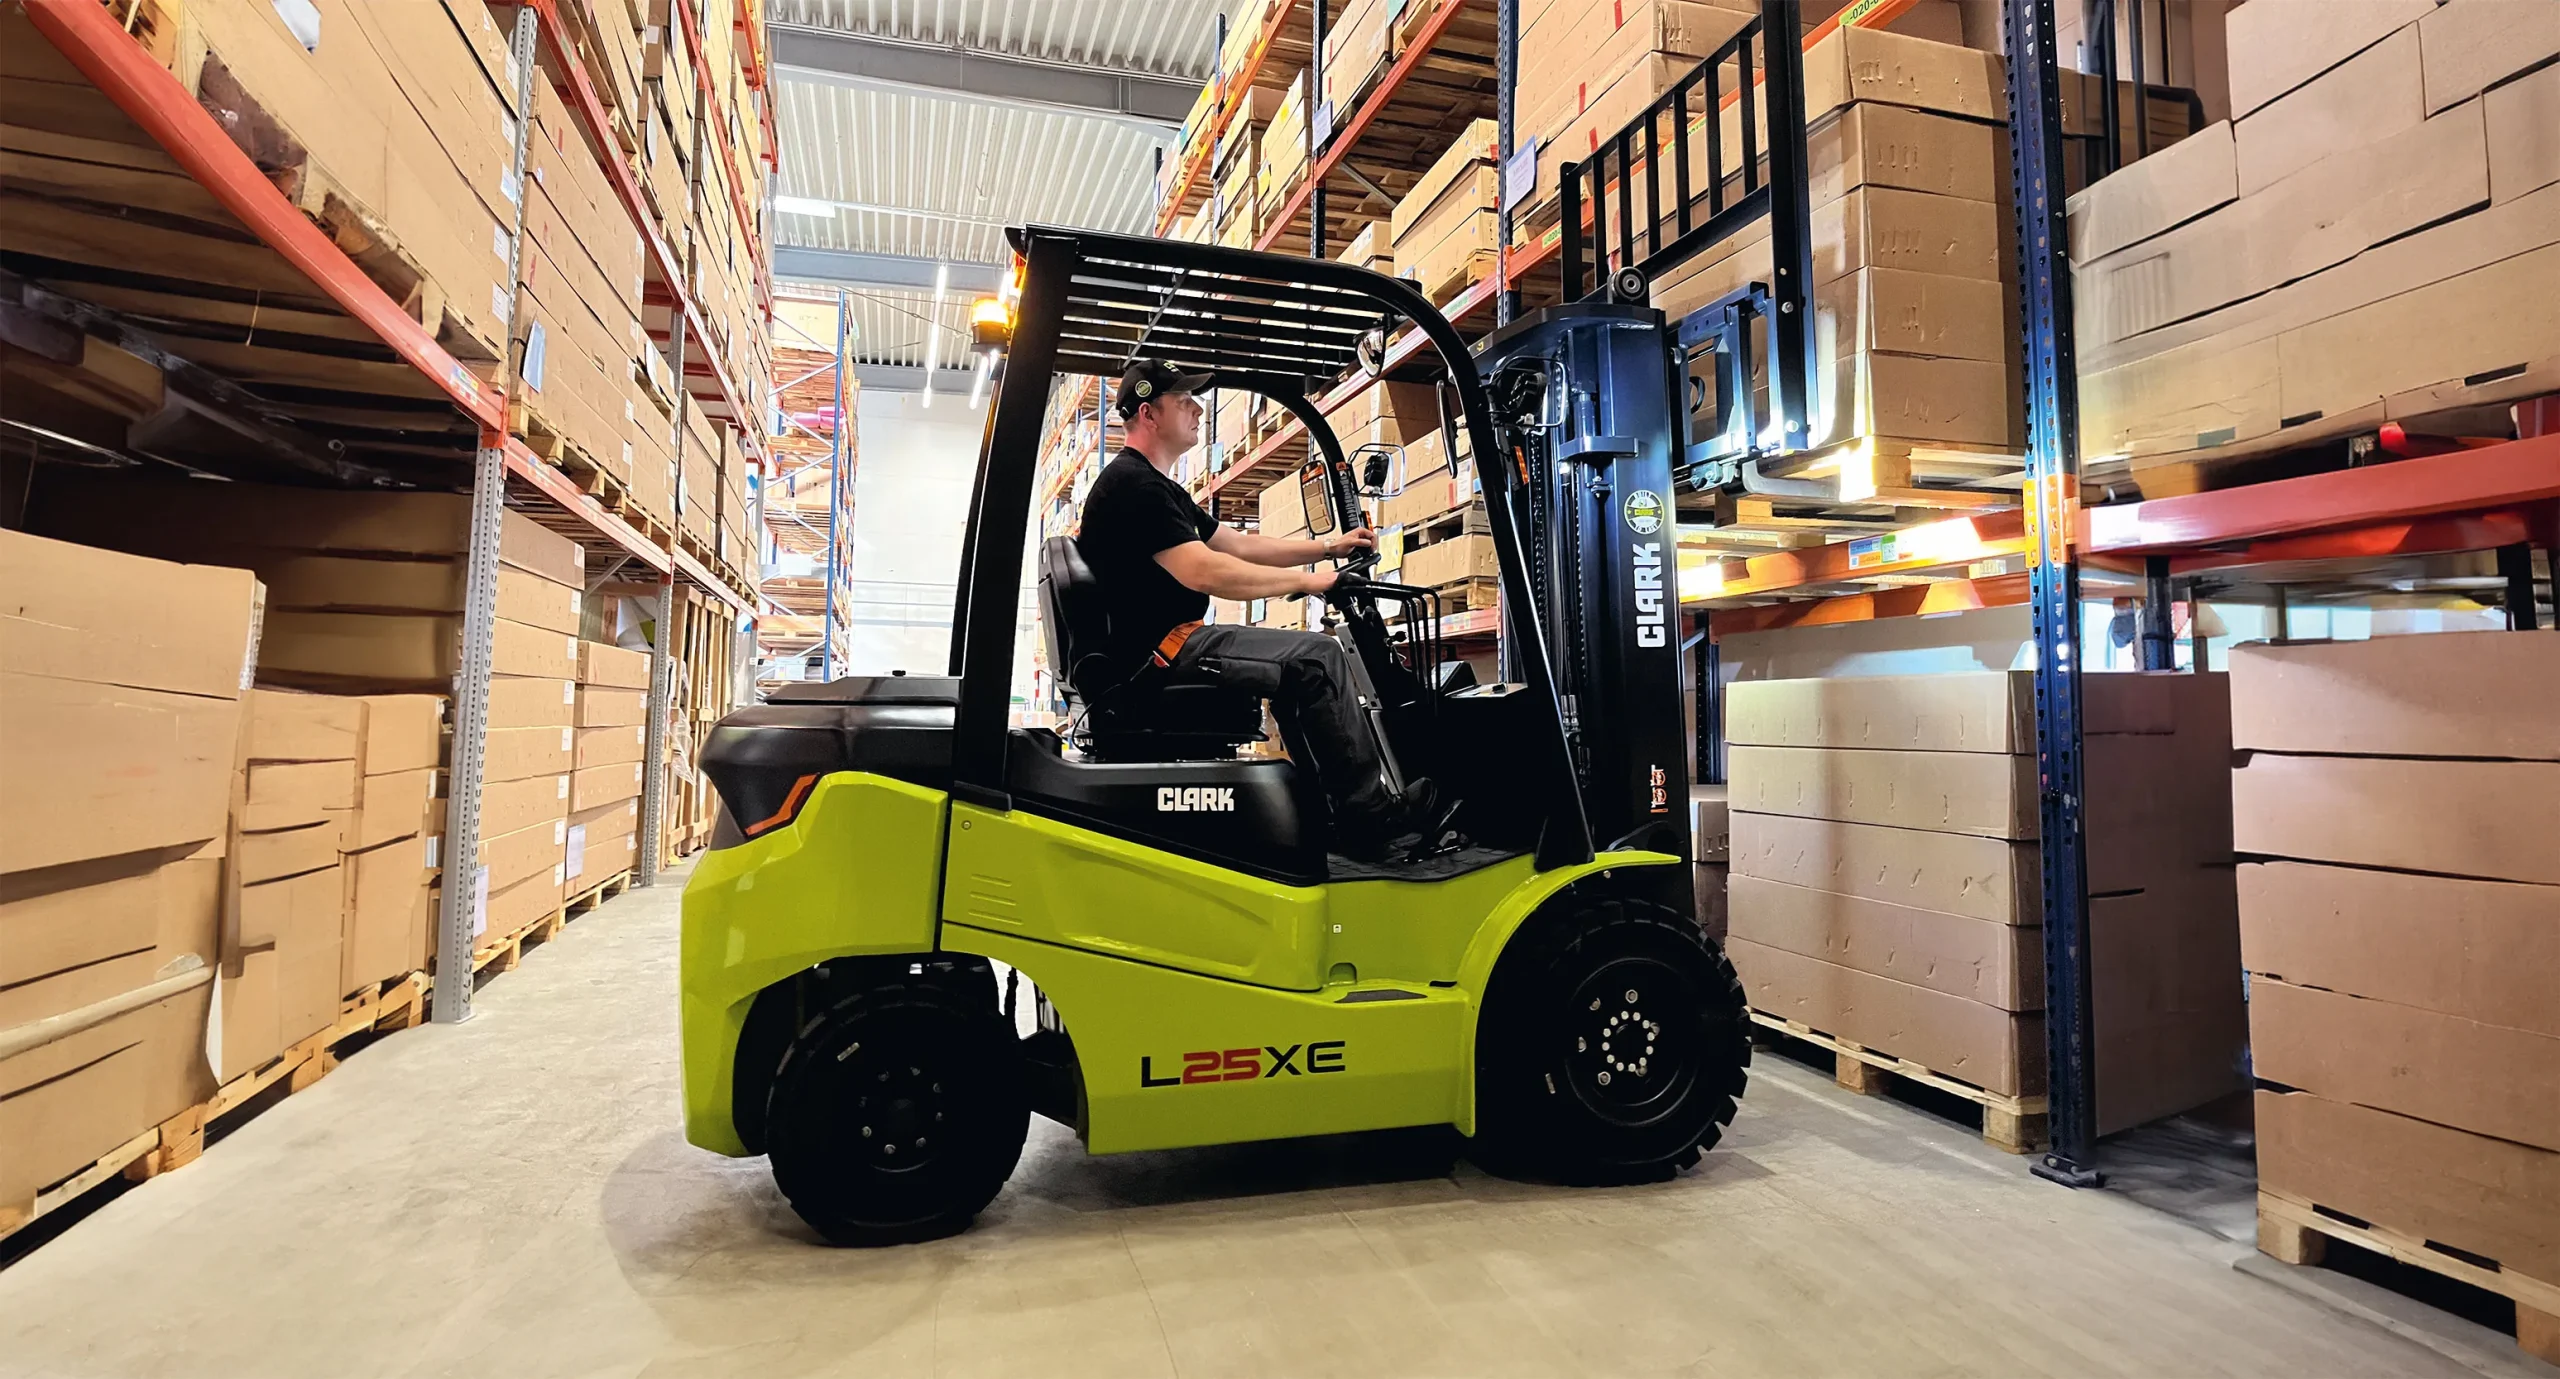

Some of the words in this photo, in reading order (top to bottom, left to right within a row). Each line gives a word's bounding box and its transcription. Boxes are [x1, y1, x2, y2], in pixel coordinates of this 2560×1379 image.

[1846, 0, 1880, 23] -020-
[1632, 542, 1665, 648] CLARK
[1157, 787, 1235, 812] CLARK
[1141, 1040, 1346, 1088] L25XE
